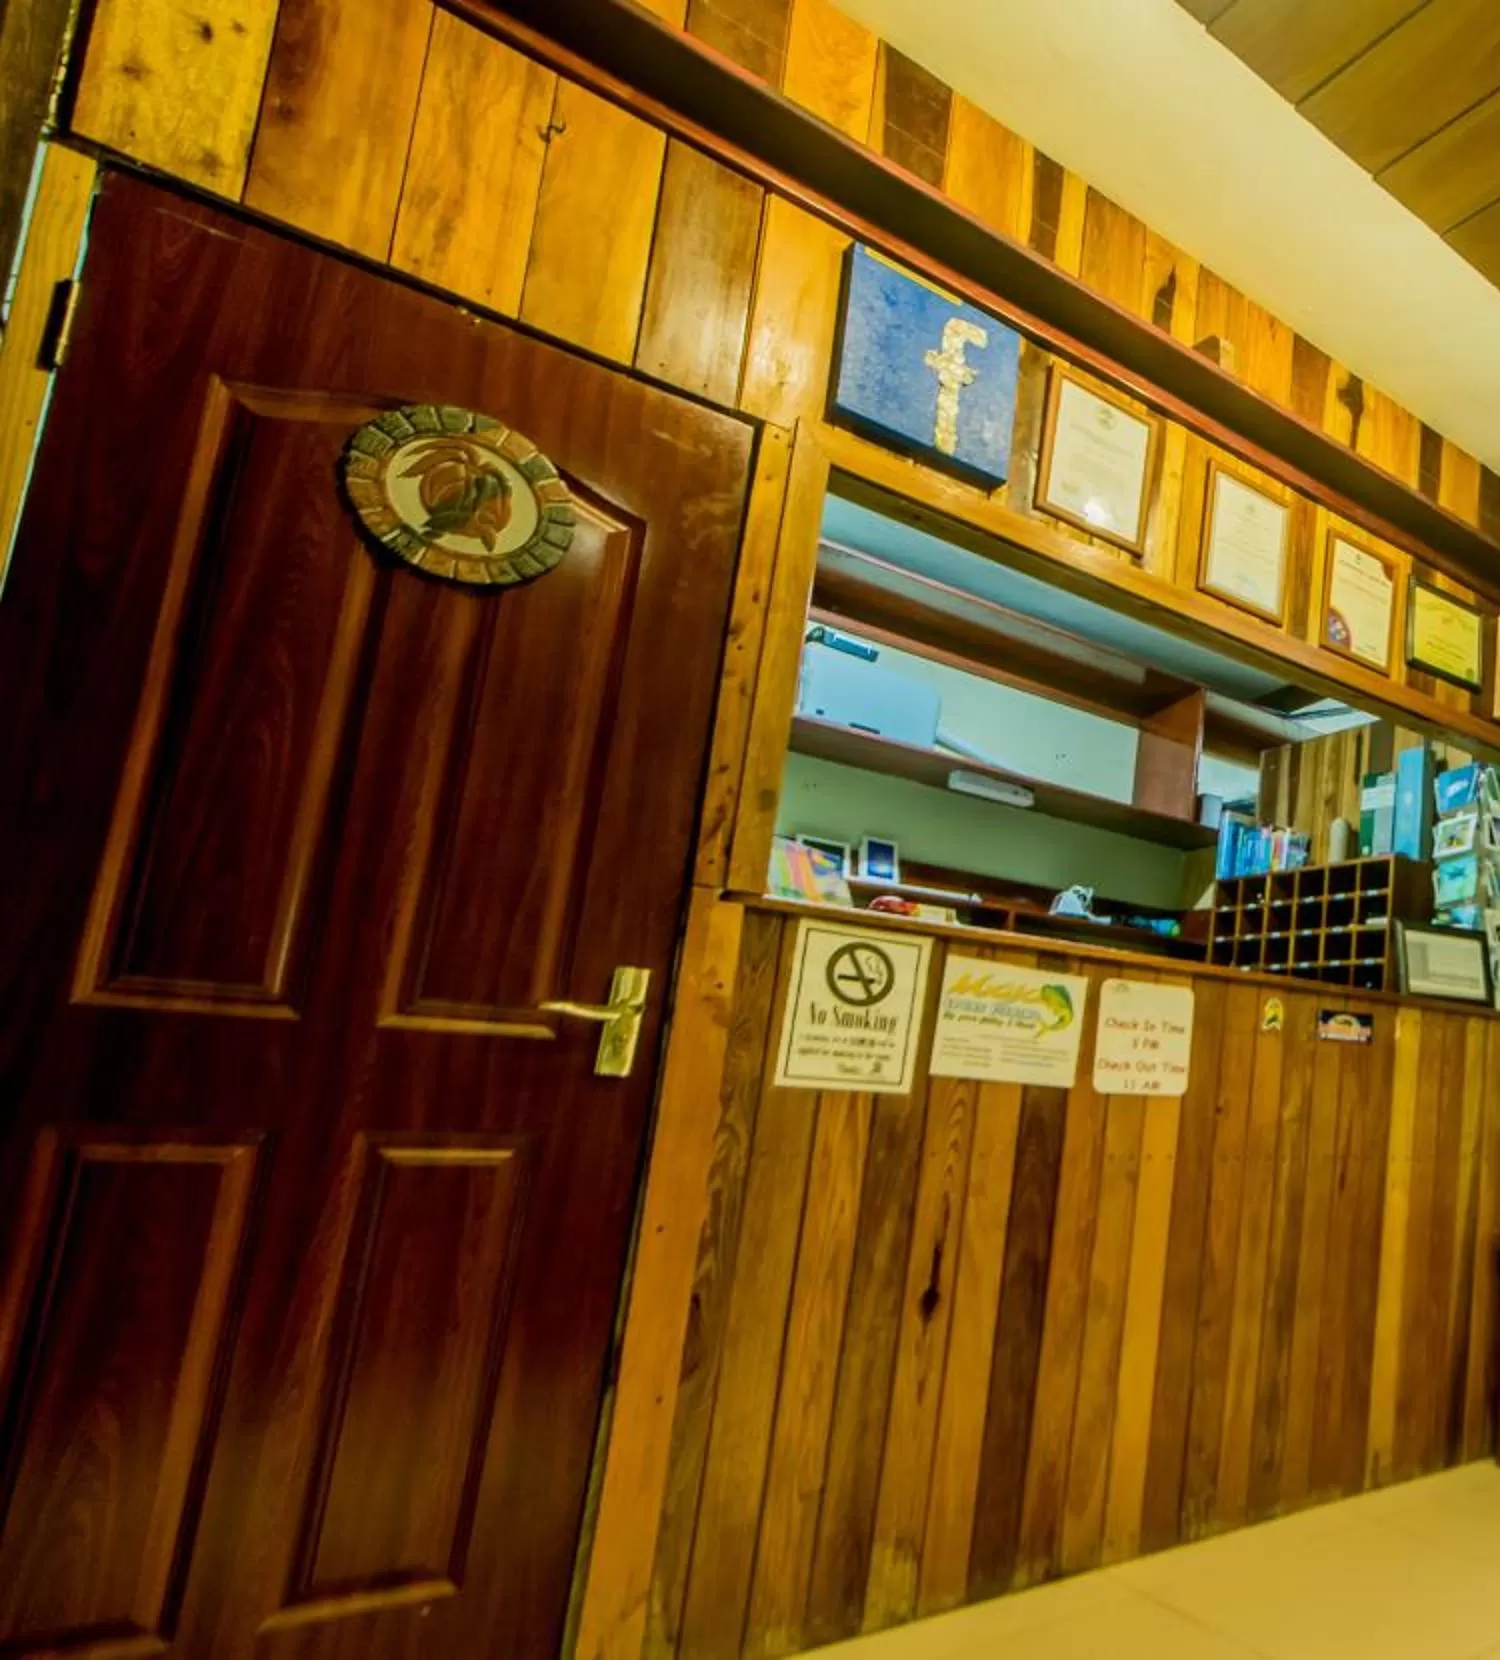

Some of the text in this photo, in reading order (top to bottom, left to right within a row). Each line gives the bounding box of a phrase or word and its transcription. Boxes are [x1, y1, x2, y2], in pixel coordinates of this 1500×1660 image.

[924, 317, 988, 456] f
[809, 1001, 898, 1036] No Smoking
